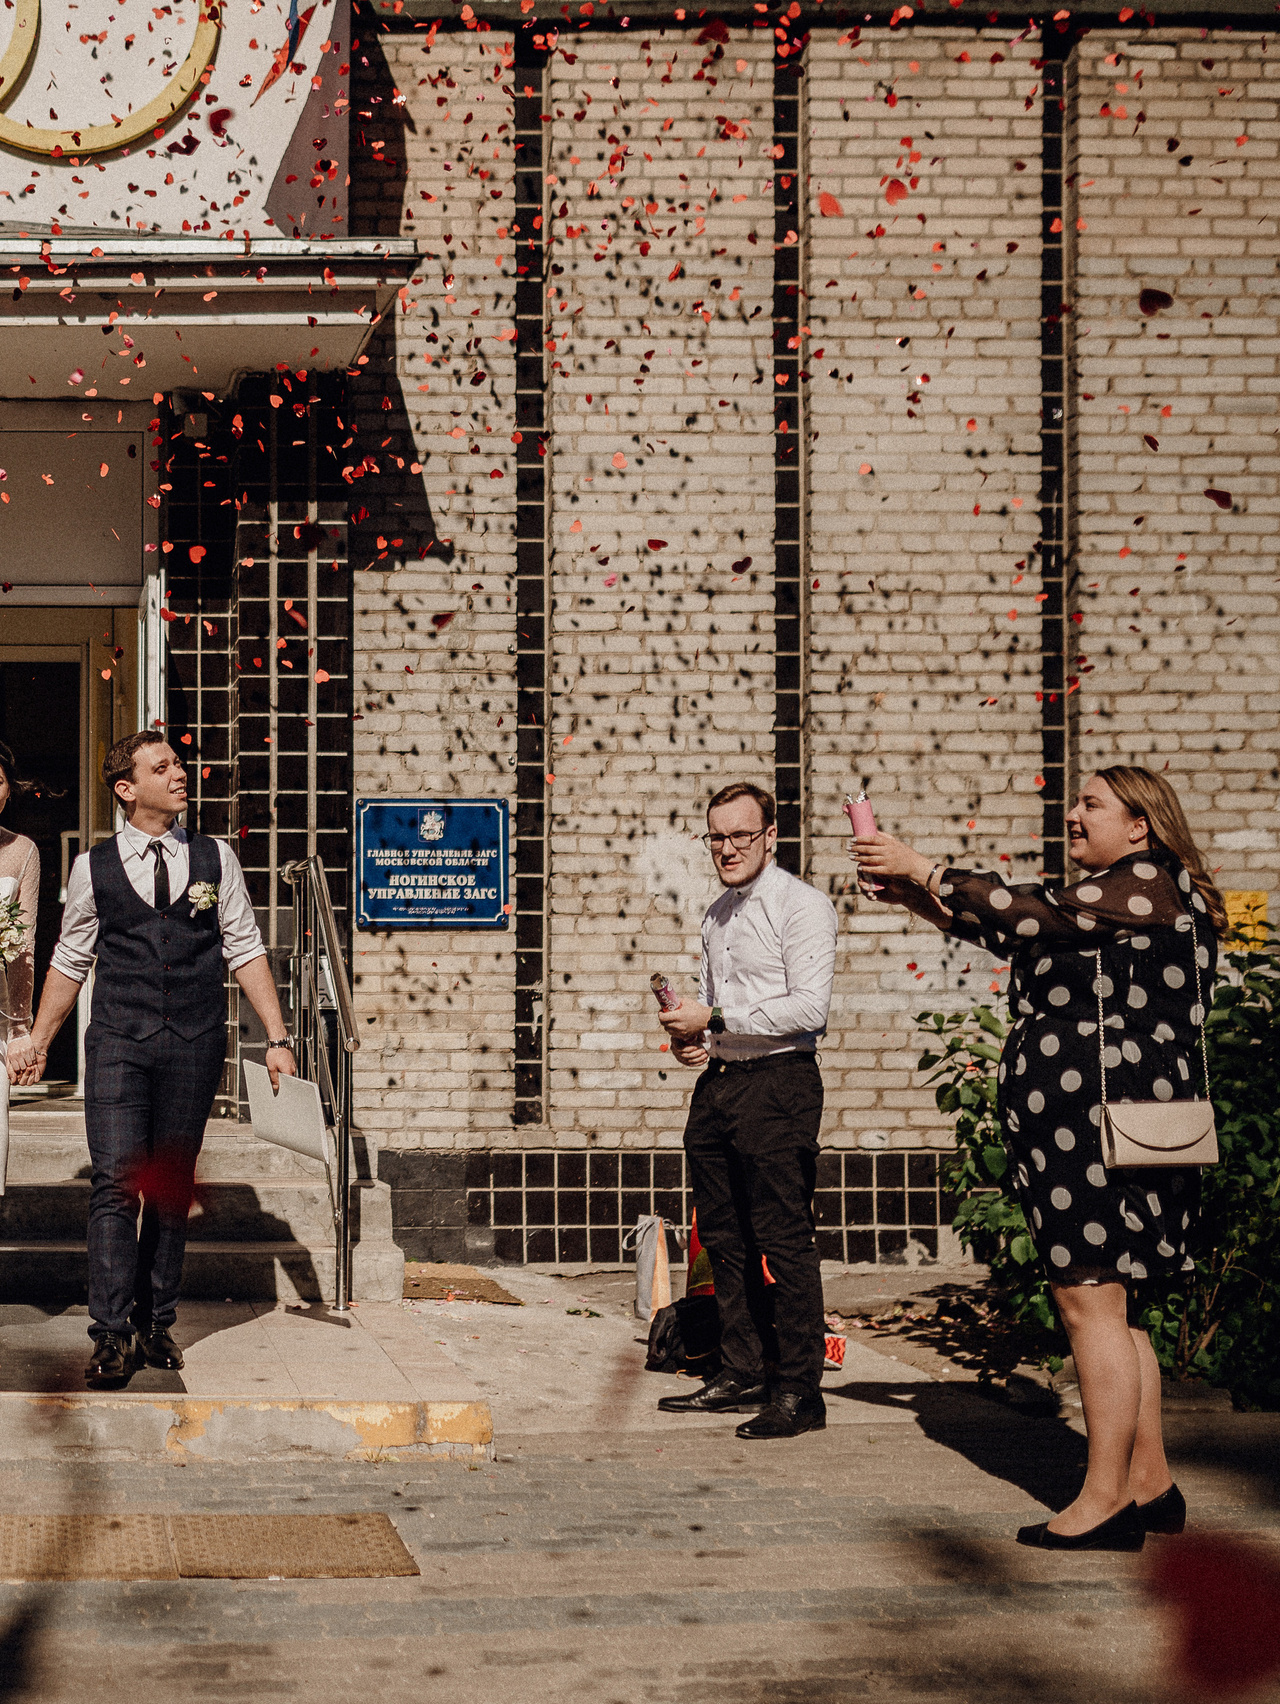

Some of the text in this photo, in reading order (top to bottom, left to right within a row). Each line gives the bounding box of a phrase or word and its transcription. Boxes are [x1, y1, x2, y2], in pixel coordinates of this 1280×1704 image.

[367, 849, 498, 858] ГЛАВНОЕ УПРАВЛЕНИЕ ЗАГС
[375, 857, 489, 866] МОСКОВСКОЙ ОБЛАСТИ
[388, 874, 476, 886] НОГИНСКОЕ
[367, 888, 498, 900] УПРАВЛЕНИЕ ЗАГС
